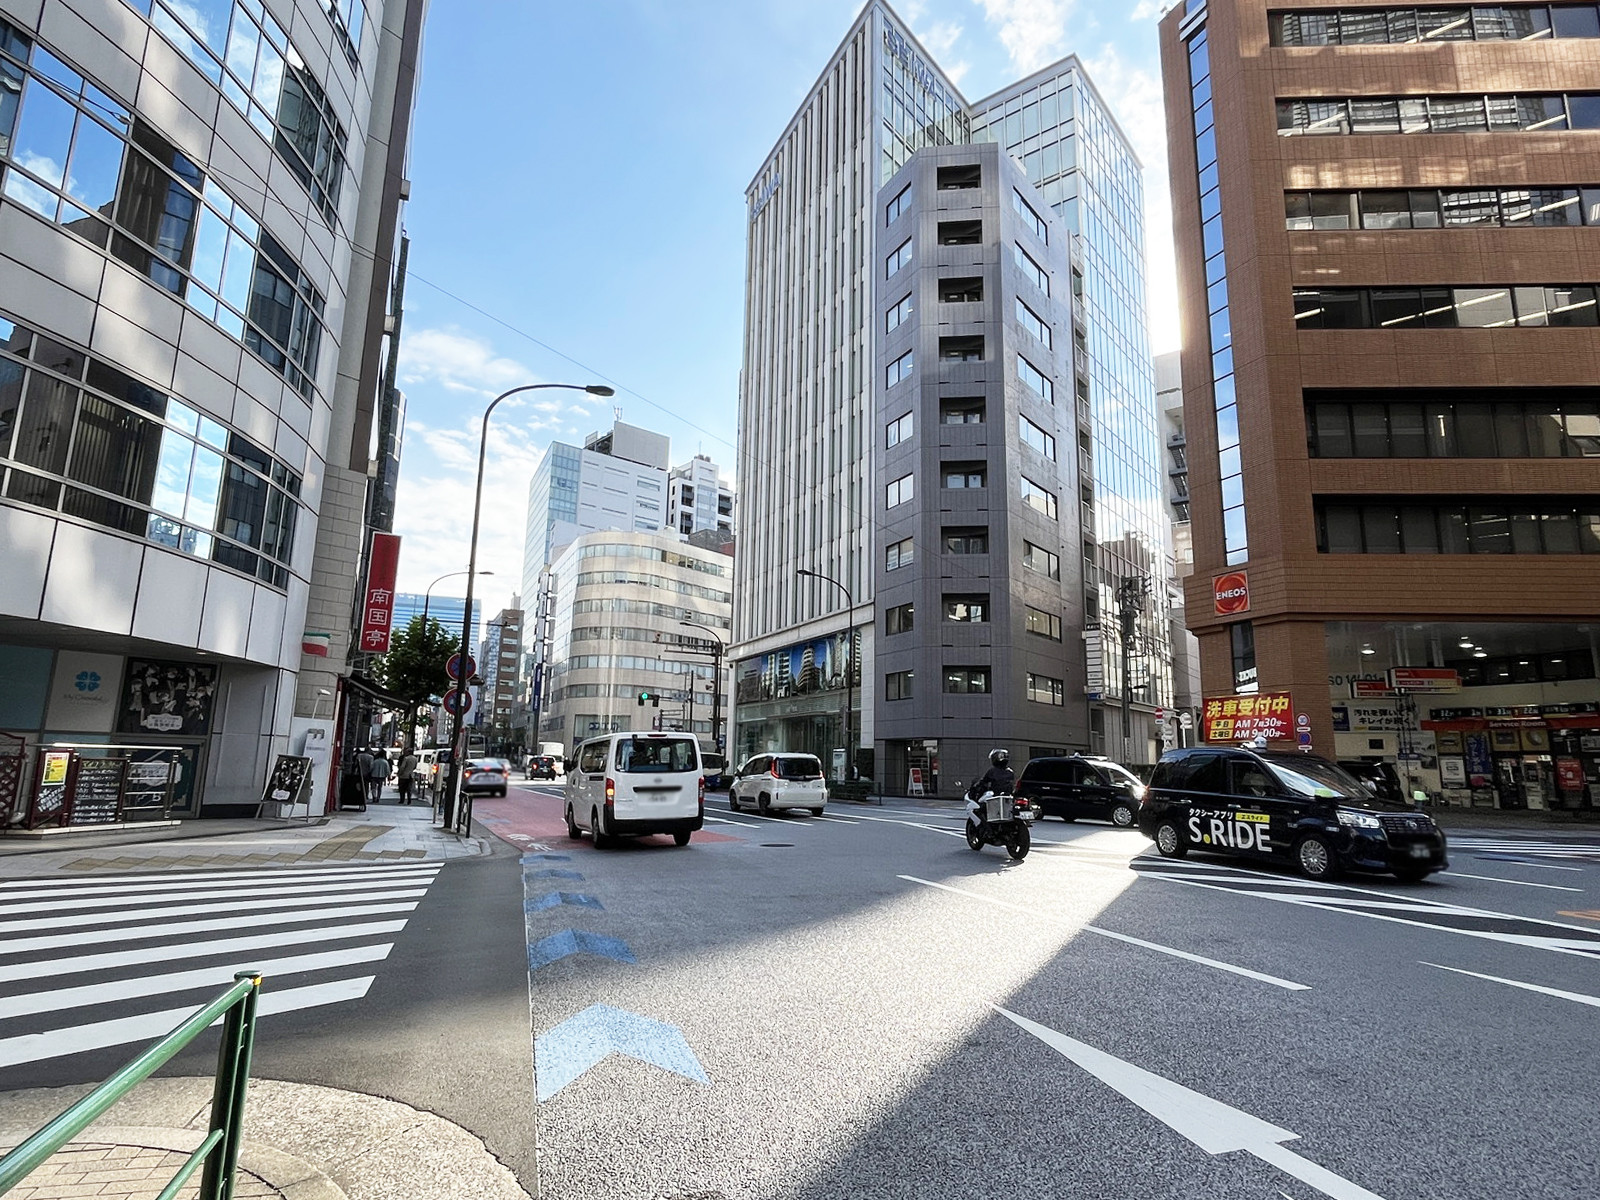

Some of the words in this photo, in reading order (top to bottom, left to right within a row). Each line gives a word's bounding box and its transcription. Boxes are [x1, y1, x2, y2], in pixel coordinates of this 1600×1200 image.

[1216, 587, 1246, 600] ENEOS
[365, 588, 392, 647] 南国亭
[1206, 696, 1289, 719] 洗車受付中
[1235, 719, 1250, 728] AM
[1212, 730, 1230, 738] 土曜日
[1234, 729, 1249, 738] AM
[1188, 808, 1233, 820] タクシーアプリ
[1188, 816, 1273, 852] S.RIDE
